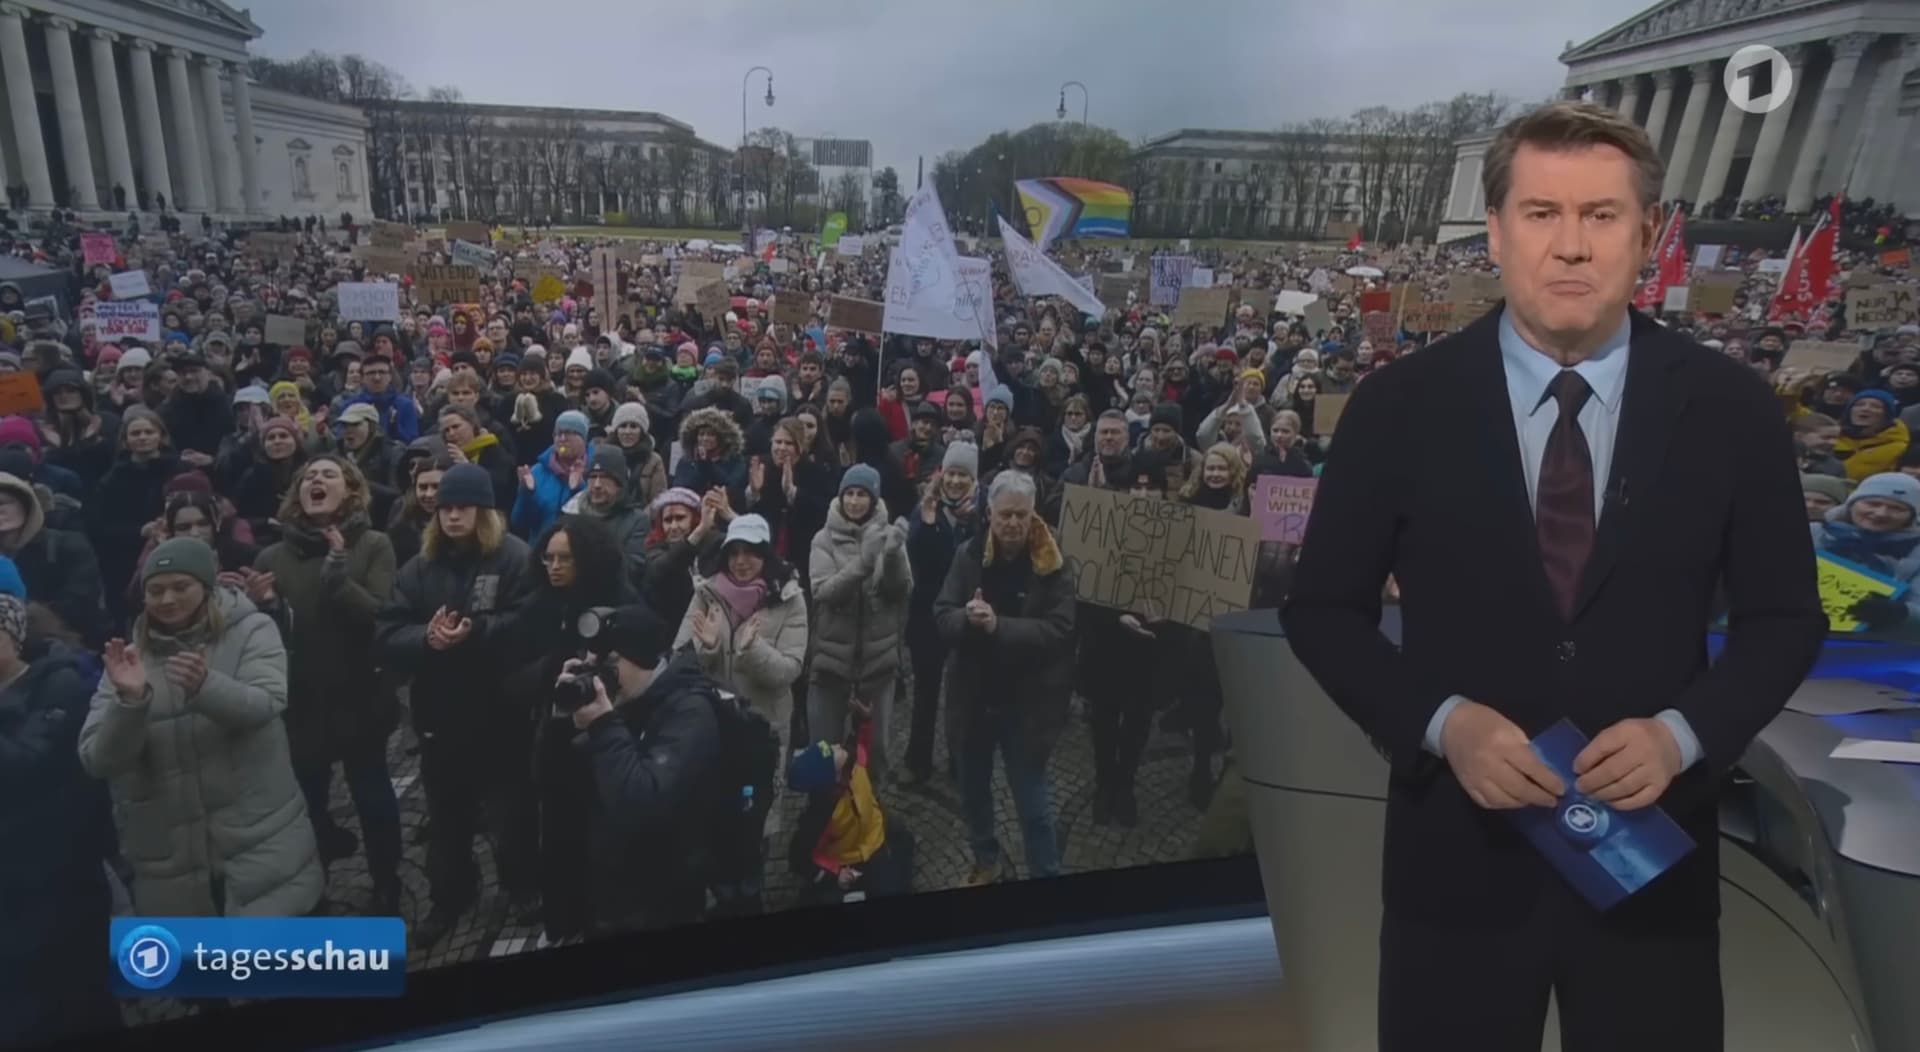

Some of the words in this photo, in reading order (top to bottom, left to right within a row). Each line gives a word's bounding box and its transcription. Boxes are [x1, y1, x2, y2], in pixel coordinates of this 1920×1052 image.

[1270, 486, 1317, 499] FILLE
[1112, 494, 1194, 520] WENIGER
[1268, 500, 1309, 512] WITH
[1063, 499, 1258, 584] MANSPLAINEN
[1107, 550, 1177, 578] MEHR
